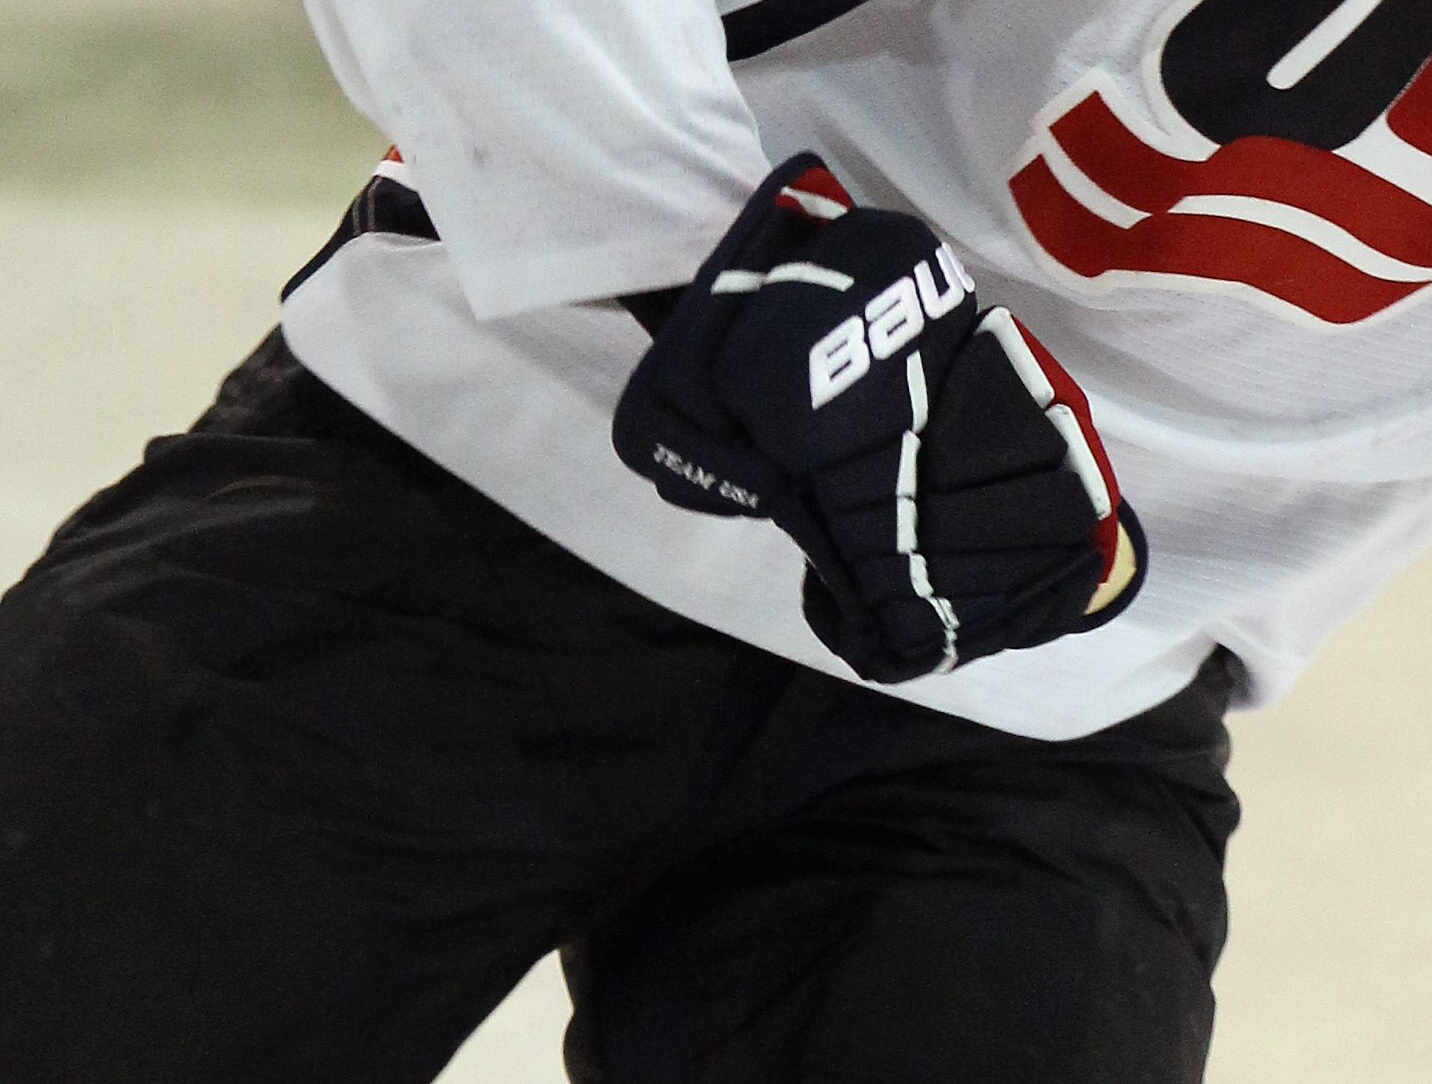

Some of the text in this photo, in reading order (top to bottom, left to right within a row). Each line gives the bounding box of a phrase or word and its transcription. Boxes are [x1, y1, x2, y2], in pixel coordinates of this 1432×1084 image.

[809, 242, 975, 410] BAU
[653, 442, 760, 509] TEAM USA
